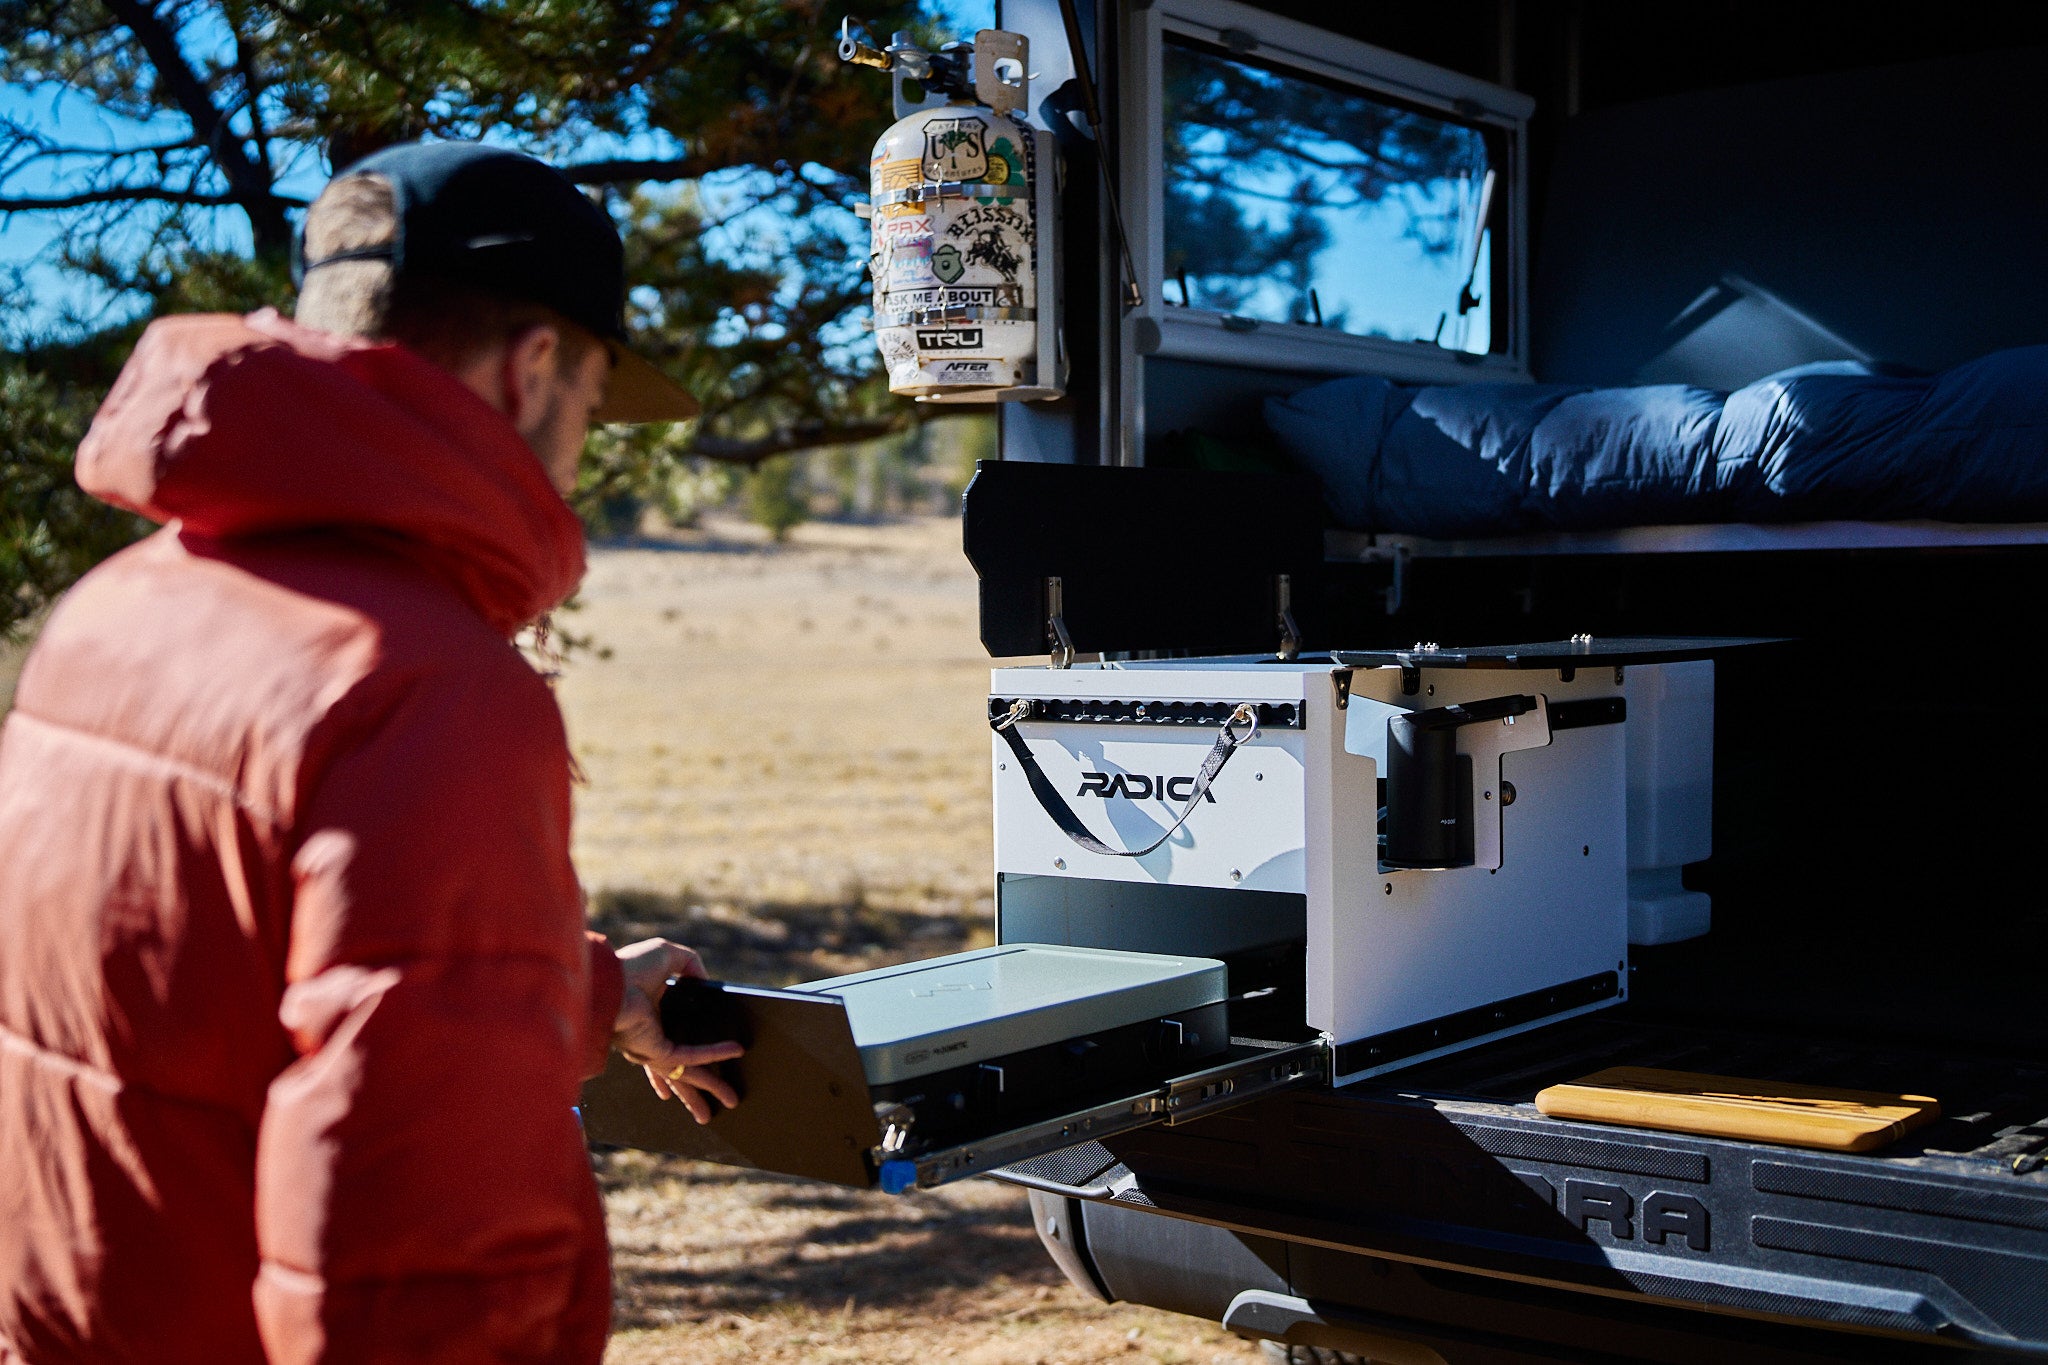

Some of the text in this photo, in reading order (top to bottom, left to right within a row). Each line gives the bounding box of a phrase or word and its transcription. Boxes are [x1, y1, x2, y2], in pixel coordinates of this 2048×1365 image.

[931, 132, 979, 160] U S
[886, 219, 931, 235] PAX
[913, 292, 932, 303] ME
[938, 290, 991, 302] ABOUT
[919, 331, 980, 347] TRU
[945, 362, 989, 371] AFTER
